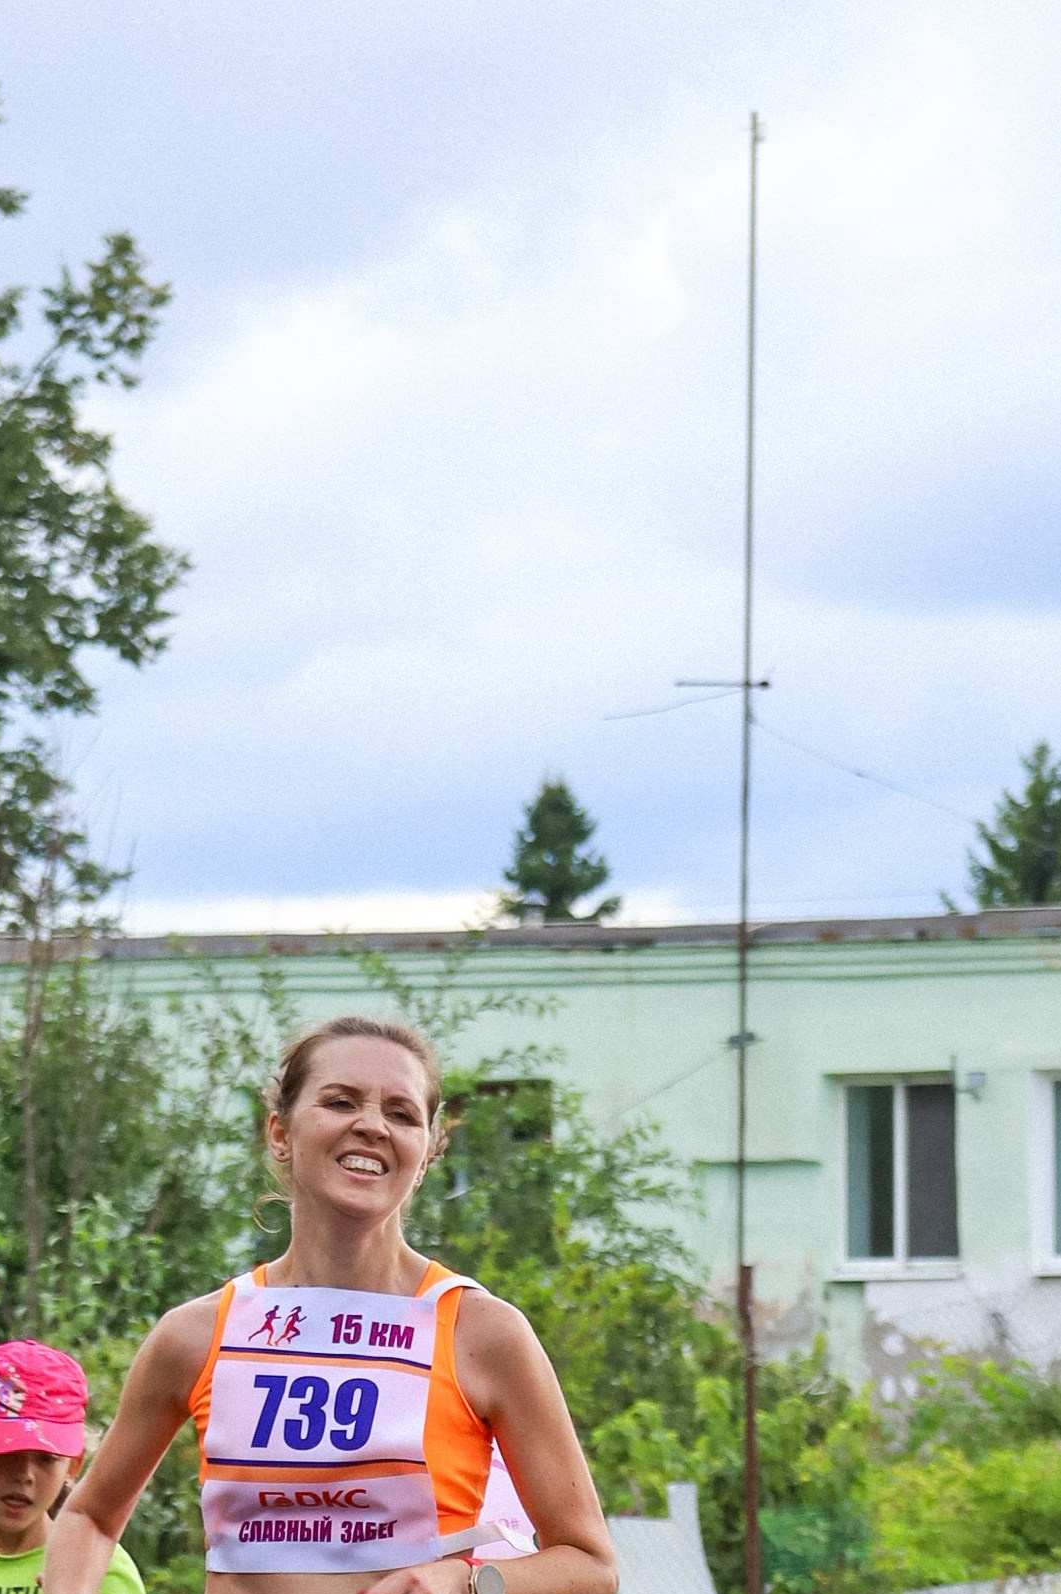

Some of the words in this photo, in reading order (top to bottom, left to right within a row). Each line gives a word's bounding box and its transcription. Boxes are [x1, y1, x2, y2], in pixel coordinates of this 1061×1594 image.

[329, 1313, 363, 1345] 15
[368, 1321, 416, 1350] КМ
[250, 1374, 380, 1451] 739
[294, 1488, 371, 1509] DKC
[239, 1515, 333, 1543] СЛАВНЫЙ
[340, 1519, 399, 1544] ЗАБЕГ
